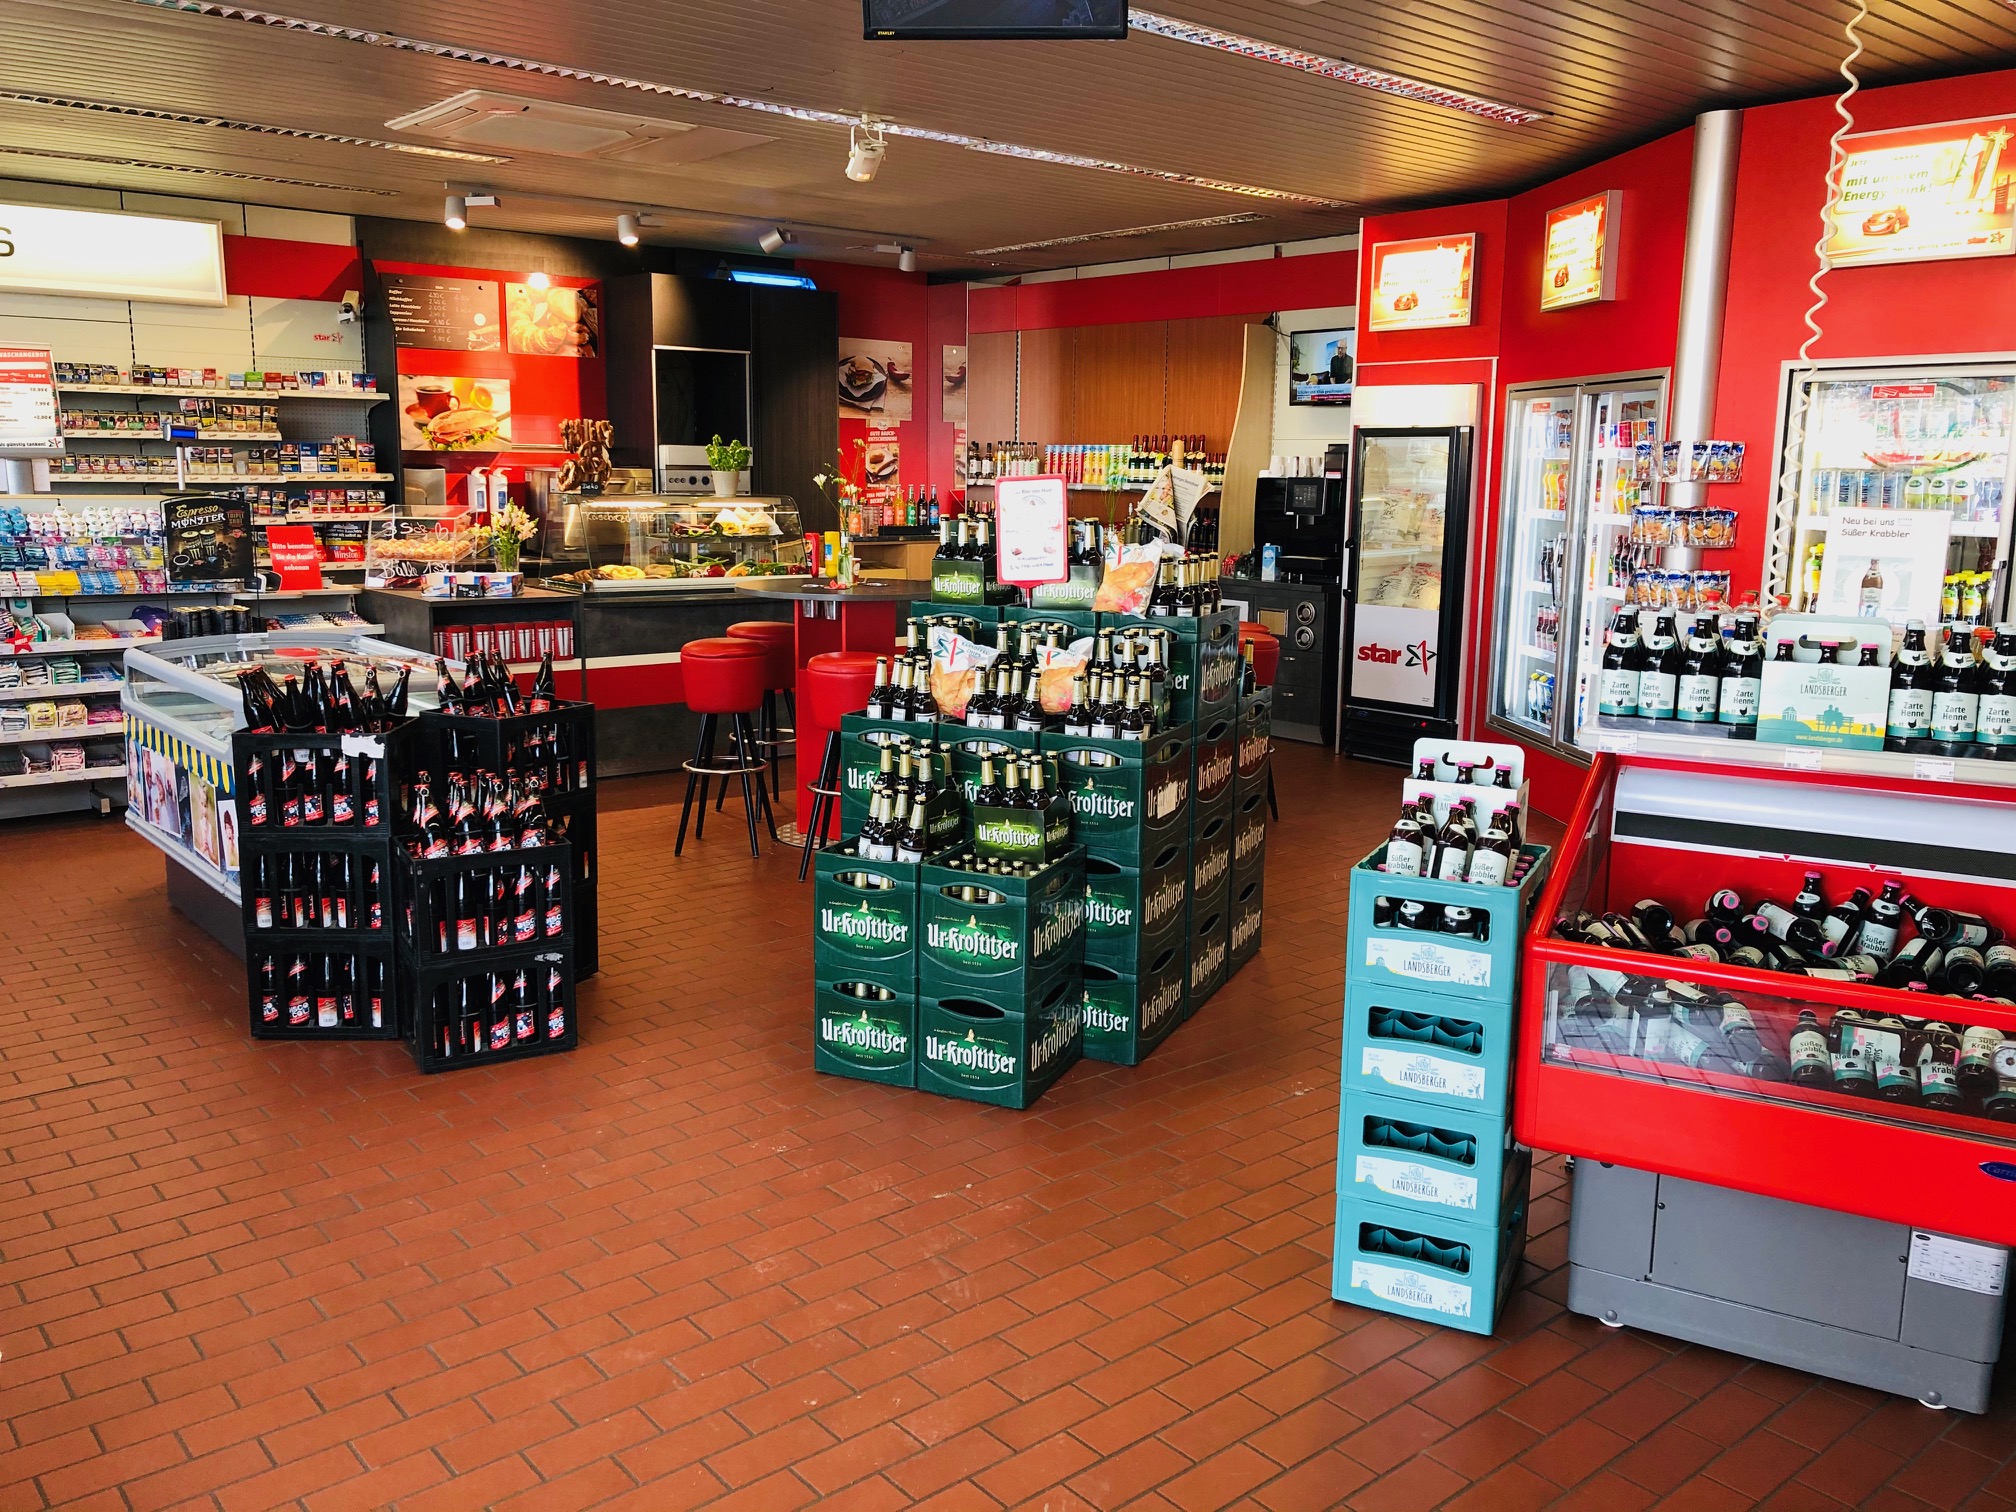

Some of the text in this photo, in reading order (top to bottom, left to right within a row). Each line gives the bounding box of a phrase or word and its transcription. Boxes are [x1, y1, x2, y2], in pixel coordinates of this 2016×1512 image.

[1846, 169, 1929, 187] mit unem
[1843, 183, 1932, 202] Energy rink!
[175, 504, 219, 518] Espresso
[171, 513, 226, 529] MONSTER
[1842, 517, 1861, 525] Neu
[1863, 517, 1877, 525] bei
[1841, 528, 1910, 538] Süßer Krabbler
[271, 542, 314, 550] Bitte benutzen
[333, 550, 359, 559] Winston
[933, 576, 981, 597] Ur-Krostitzer
[1036, 583, 1096, 601] Ur-Krostitzer
[1357, 642, 1402, 665] star
[1611, 681, 1630, 689] Zarte
[1643, 683, 1660, 692] Zarte
[1691, 687, 1710, 695] Zarte
[1800, 684, 1847, 697] LANDSBERGER
[1609, 688, 1631, 696] Henne
[1641, 690, 1661, 698] Henne
[1689, 694, 1711, 702] Henne
[1735, 690, 1754, 698] Zarte
[1733, 697, 1755, 705] Henne
[1900, 709, 1925, 717] Henne
[1945, 705, 1966, 713] Zarte
[1988, 708, 2010, 716] Zarte
[1942, 713, 1968, 721] Henne
[1985, 715, 2011, 723] Henne
[1795, 734, 1843, 744] www.landsberger.de
[1198, 755, 1232, 792] Ur-Krostitzer
[1067, 790, 1135, 819] Krostitzer
[977, 824, 1040, 848] Ur-Krostitzer
[1391, 854, 1411, 863] Süßer
[1194, 848, 1230, 891] Ur-Krostitzer
[1387, 861, 1414, 871] Krabbler
[1474, 862, 1494, 872] Süßer
[1470, 870, 1497, 881] Krabbler
[1144, 879, 1186, 925] Ur-Krostitzer
[1085, 901, 1132, 927] stitzer
[821, 908, 909, 944] Ur-Krostitzer
[927, 922, 1019, 961] Ur-Krostitzer
[1860, 940, 1889, 953] Krabbler
[1865, 934, 1886, 947] Süßer
[1191, 940, 1226, 988] Ur-Krostitzer
[1403, 960, 1452, 977] LANDSBERGER
[1142, 978, 1183, 1031] Ur-Krostitzer
[1082, 1006, 1130, 1032] stitzer
[821, 1017, 908, 1054] Ur-Krostitzer
[1031, 1013, 1081, 1072] Ur-Krostitzer
[926, 1036, 1017, 1075] Ur-Krostitzer
[1931, 1065, 1956, 1075] Krabb
[1399, 1070, 1447, 1089] LANDSBERGER
[1391, 1178, 1439, 1198] LANDSBERGER
[1387, 1284, 1433, 1305] LANDSBERGER
